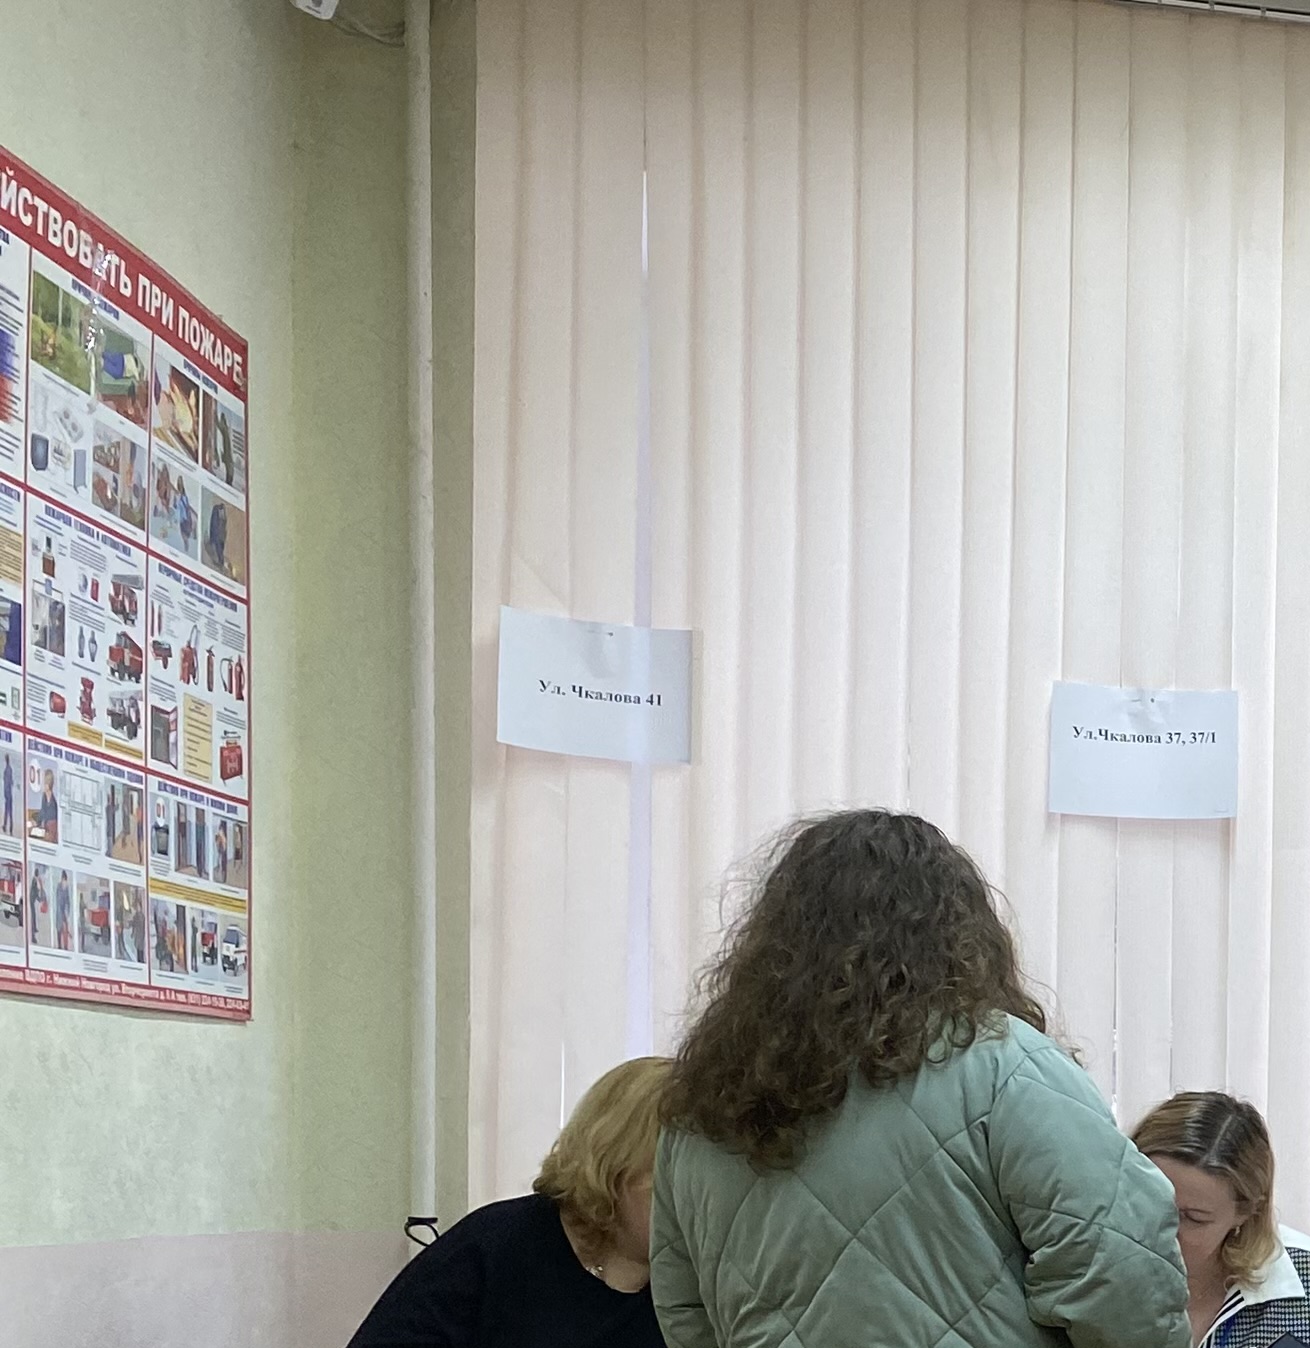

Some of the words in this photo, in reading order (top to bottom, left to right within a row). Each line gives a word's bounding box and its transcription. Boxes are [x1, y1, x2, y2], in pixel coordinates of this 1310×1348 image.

[137, 273, 175, 332] ПРИ
[539, 679, 567, 696] Ул.
[571, 684, 642, 705] Чкалова
[645, 693, 662, 706] 41
[1072, 726, 1162, 744] Ул.Чкалова
[1165, 731, 1186, 746] 37,
[1189, 731, 1217, 744] 37/1
